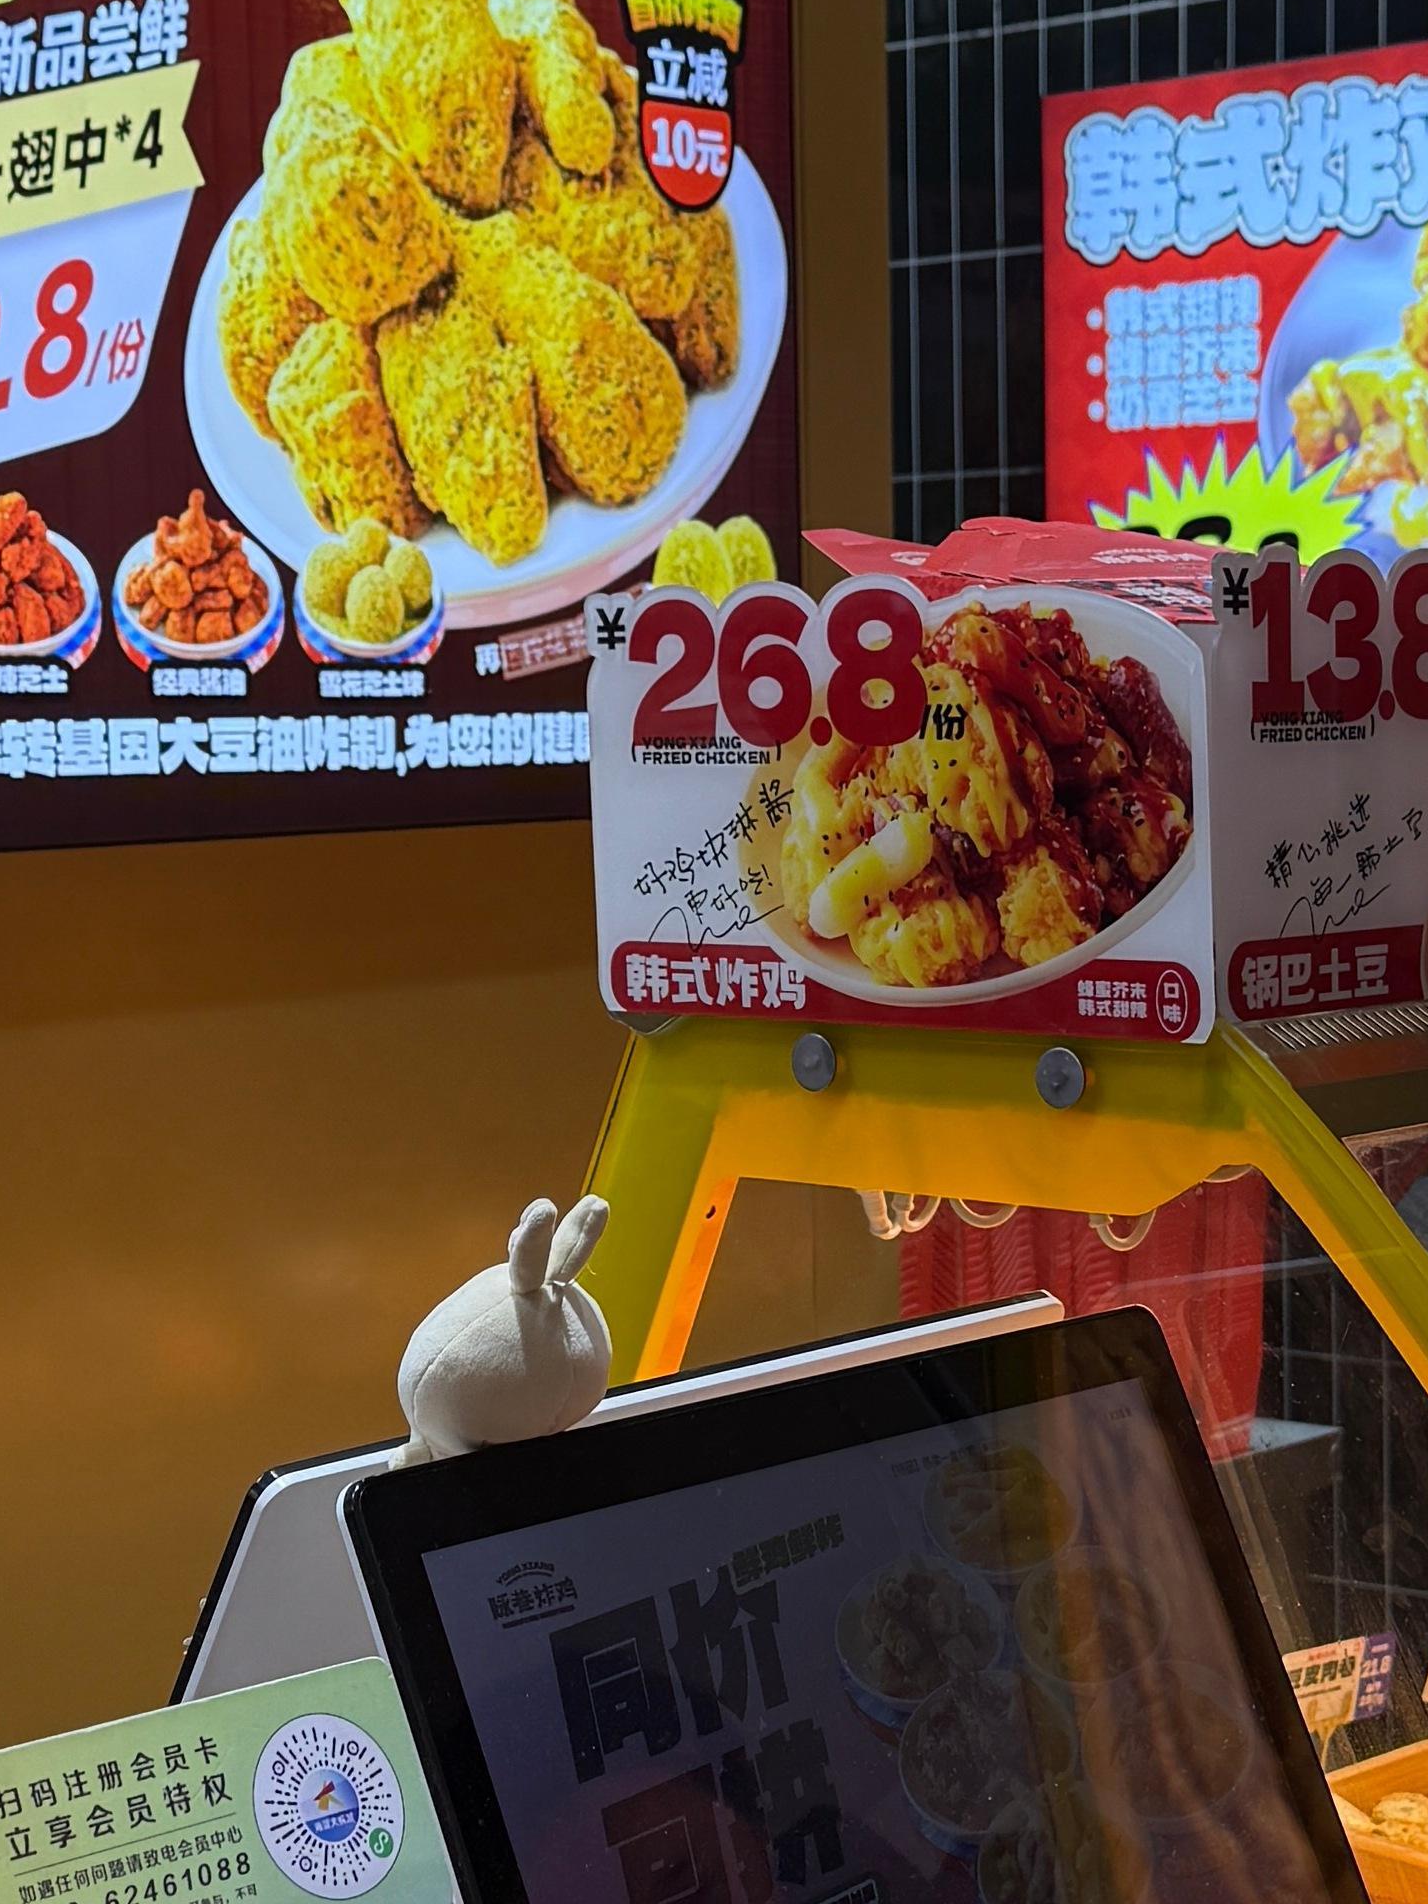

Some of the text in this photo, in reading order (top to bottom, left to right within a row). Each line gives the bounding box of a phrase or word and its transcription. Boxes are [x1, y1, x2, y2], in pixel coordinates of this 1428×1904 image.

[645, 38, 729, 106] 立减
[652, 117, 728, 176] 10元
[642, 736, 742, 750] YONG XIANG
[642, 751, 771, 765] FRIED CHICKEN
[1259, 725, 1366, 743] FRIED CHICKEN
[625, 954, 807, 1010] 韩式炸鸡
[1162, 982, 1182, 1023] 口味
[1241, 943, 1389, 1010] 锅巴土豆
[549, 1566, 789, 1784] 同价
[4, 1773, 233, 1862] 立享会员特权
